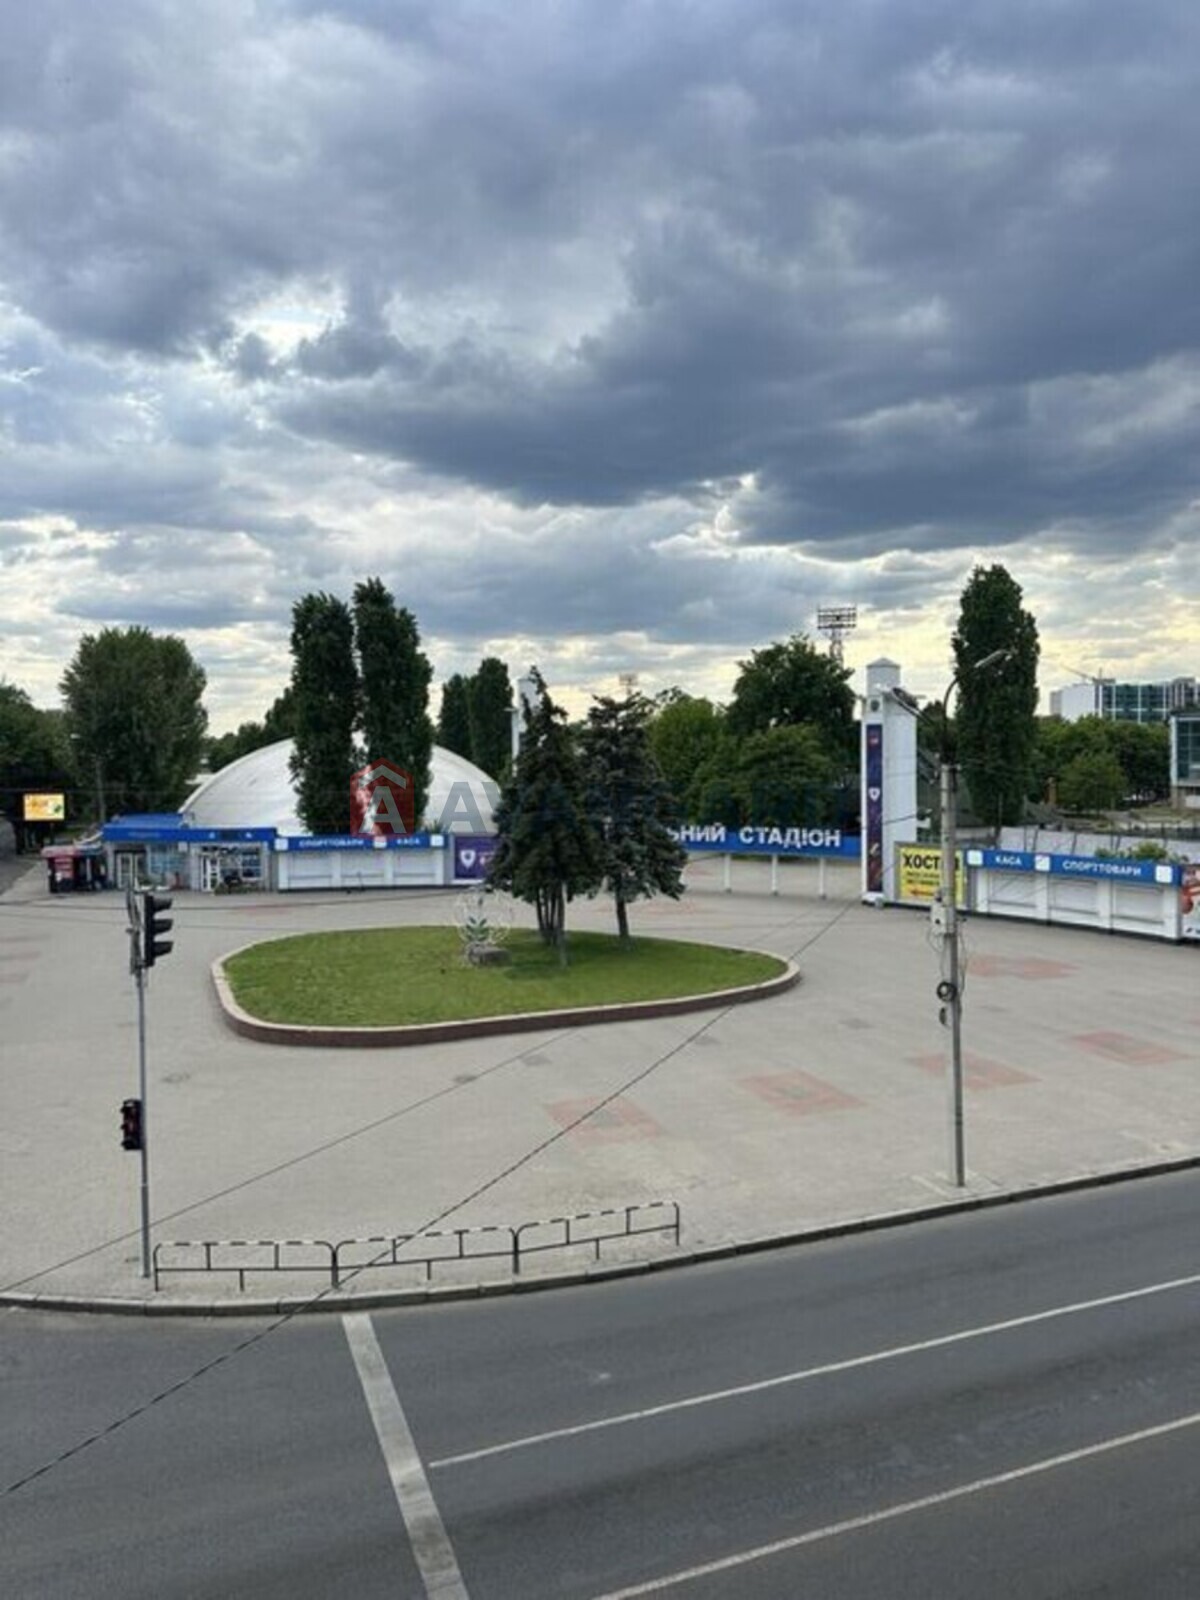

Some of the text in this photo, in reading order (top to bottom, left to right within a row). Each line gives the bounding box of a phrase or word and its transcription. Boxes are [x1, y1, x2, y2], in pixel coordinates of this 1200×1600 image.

[739, 826, 841, 849] СТАДІОН
[902, 853, 960, 871] ХОСТ
[995, 854, 1022, 866] КАСА
[1062, 859, 1142, 876] СПОРТТОВАРИ
